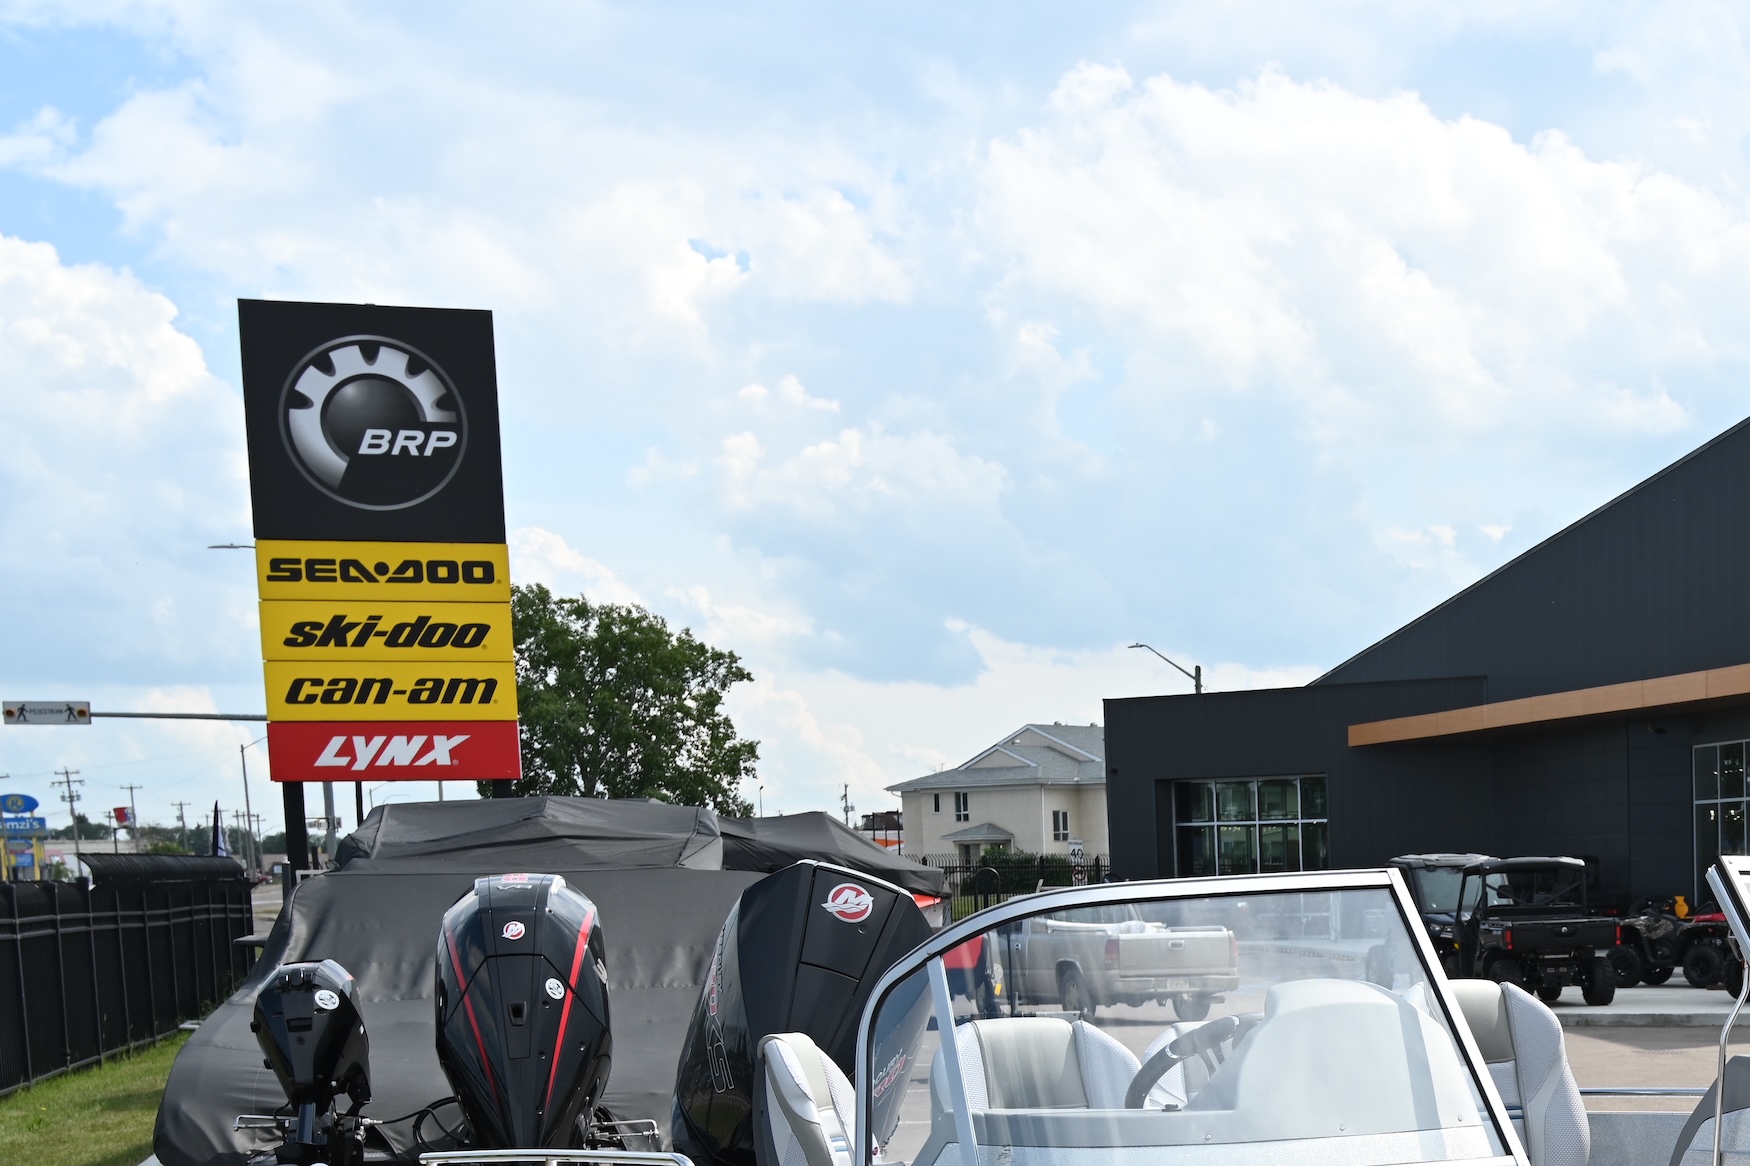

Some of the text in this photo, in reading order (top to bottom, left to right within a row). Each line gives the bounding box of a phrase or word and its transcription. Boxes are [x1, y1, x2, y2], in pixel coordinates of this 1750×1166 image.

[358, 428, 458, 457] BRP
[285, 678, 498, 704] can-am
[313, 735, 471, 771] LYNX
[1071, 848, 1084, 860] 40
